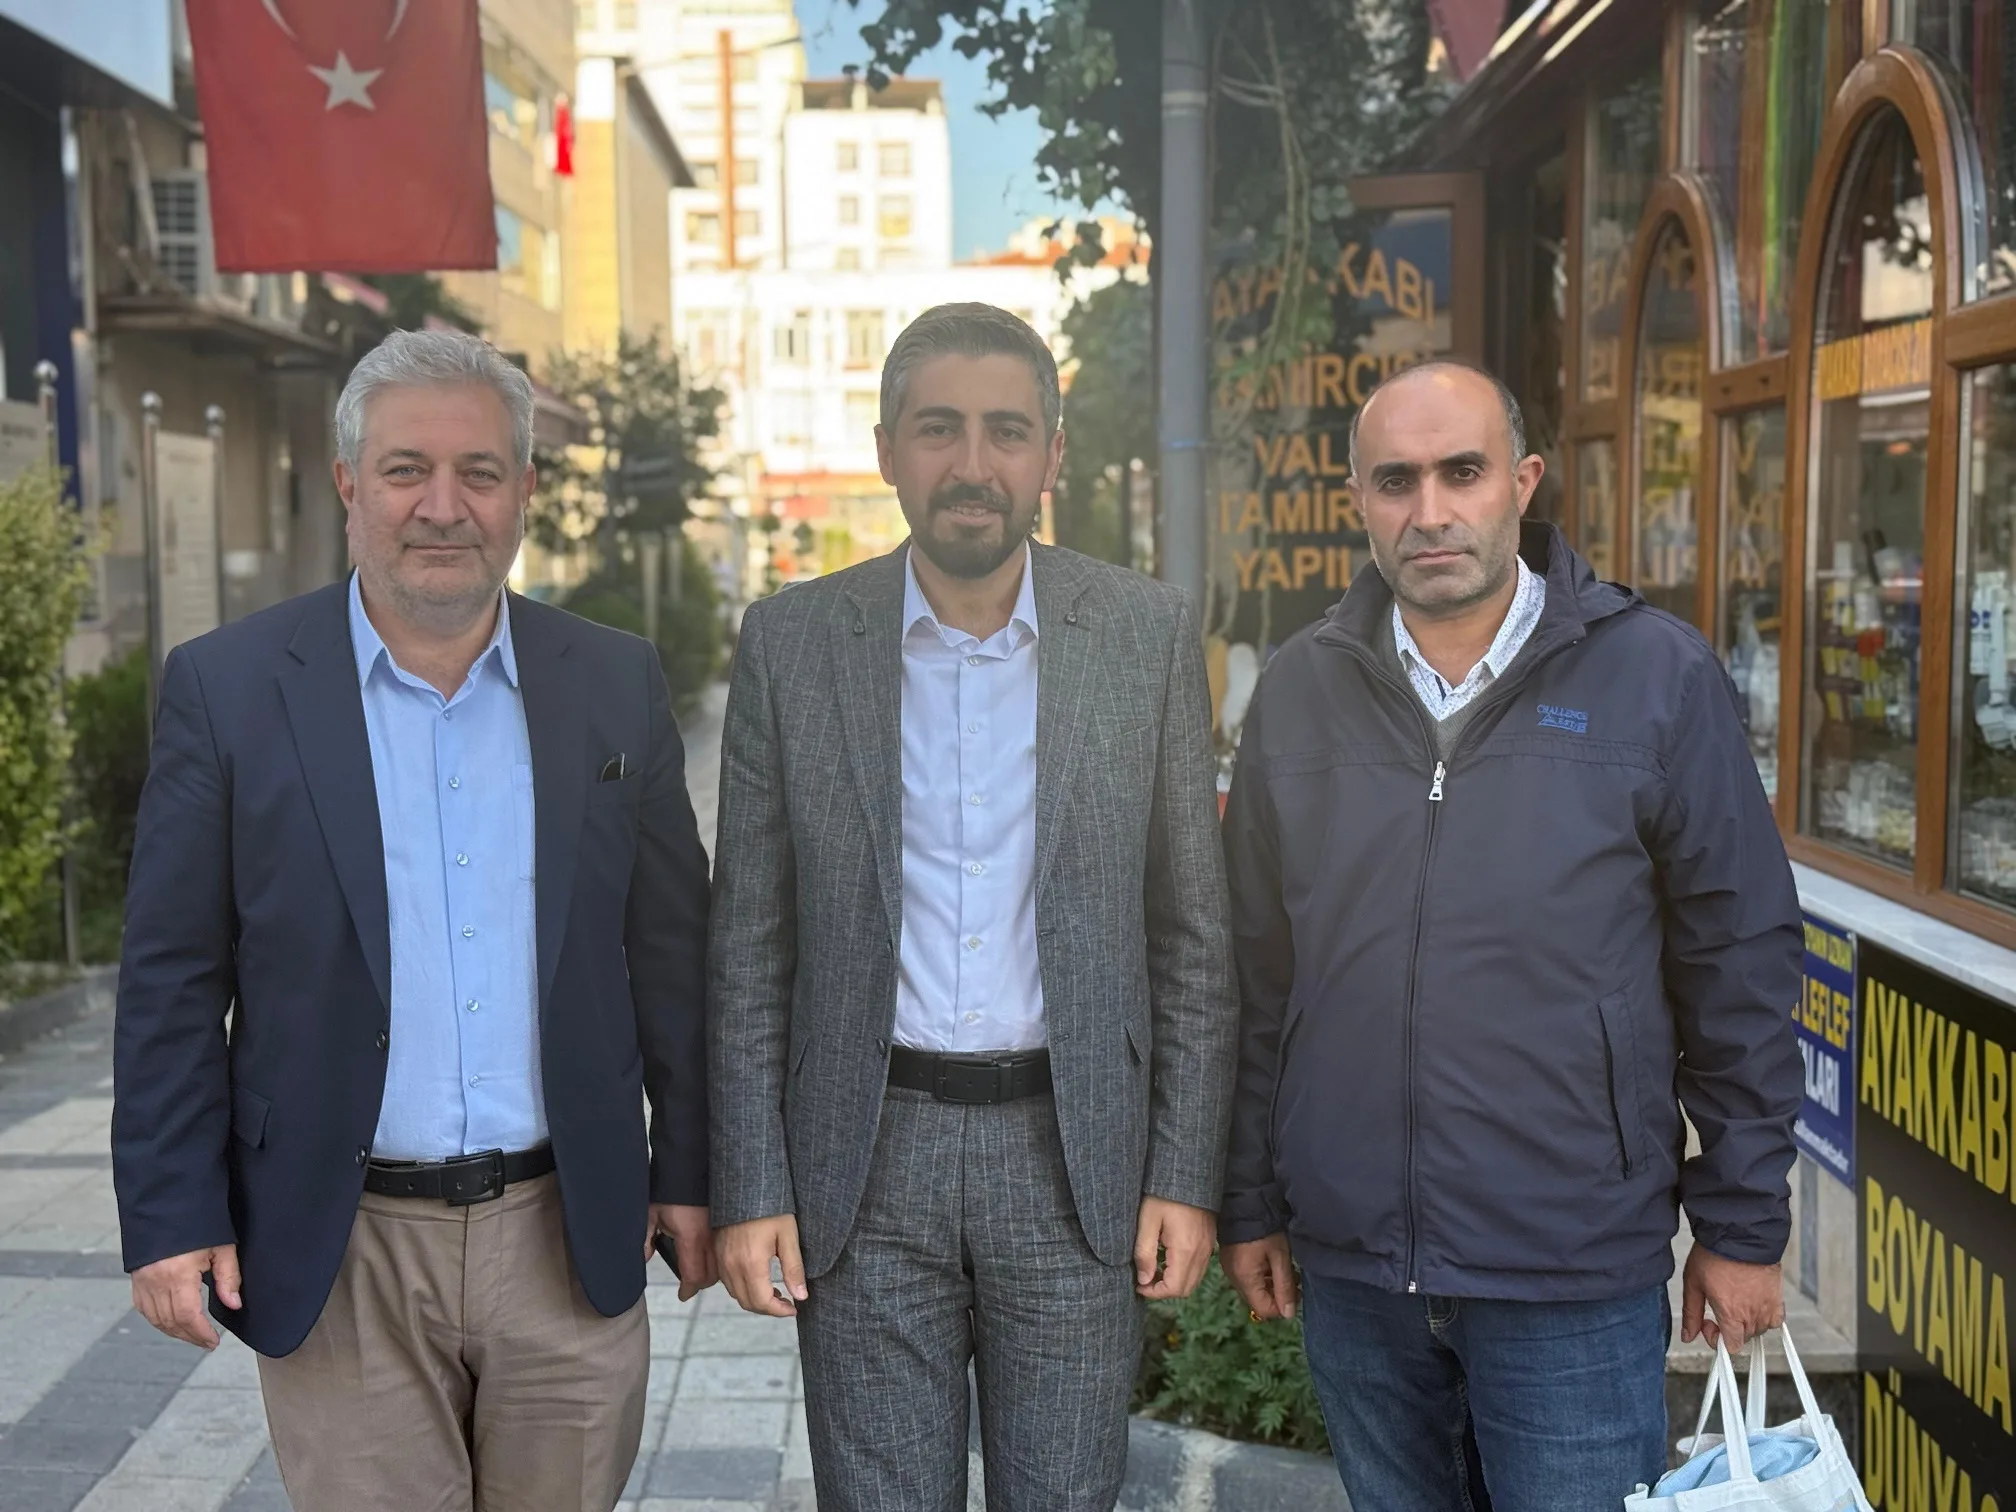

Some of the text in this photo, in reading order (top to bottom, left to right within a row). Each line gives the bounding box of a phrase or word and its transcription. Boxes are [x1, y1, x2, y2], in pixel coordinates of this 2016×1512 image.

[1212, 243, 1435, 331] AYAKABI
[1254, 432, 1348, 478] VAL
[1233, 546, 1351, 591] YAPIL
[1866, 1175, 2013, 1436] BOYAMA
[1864, 1365, 2001, 1512] DÜNY
